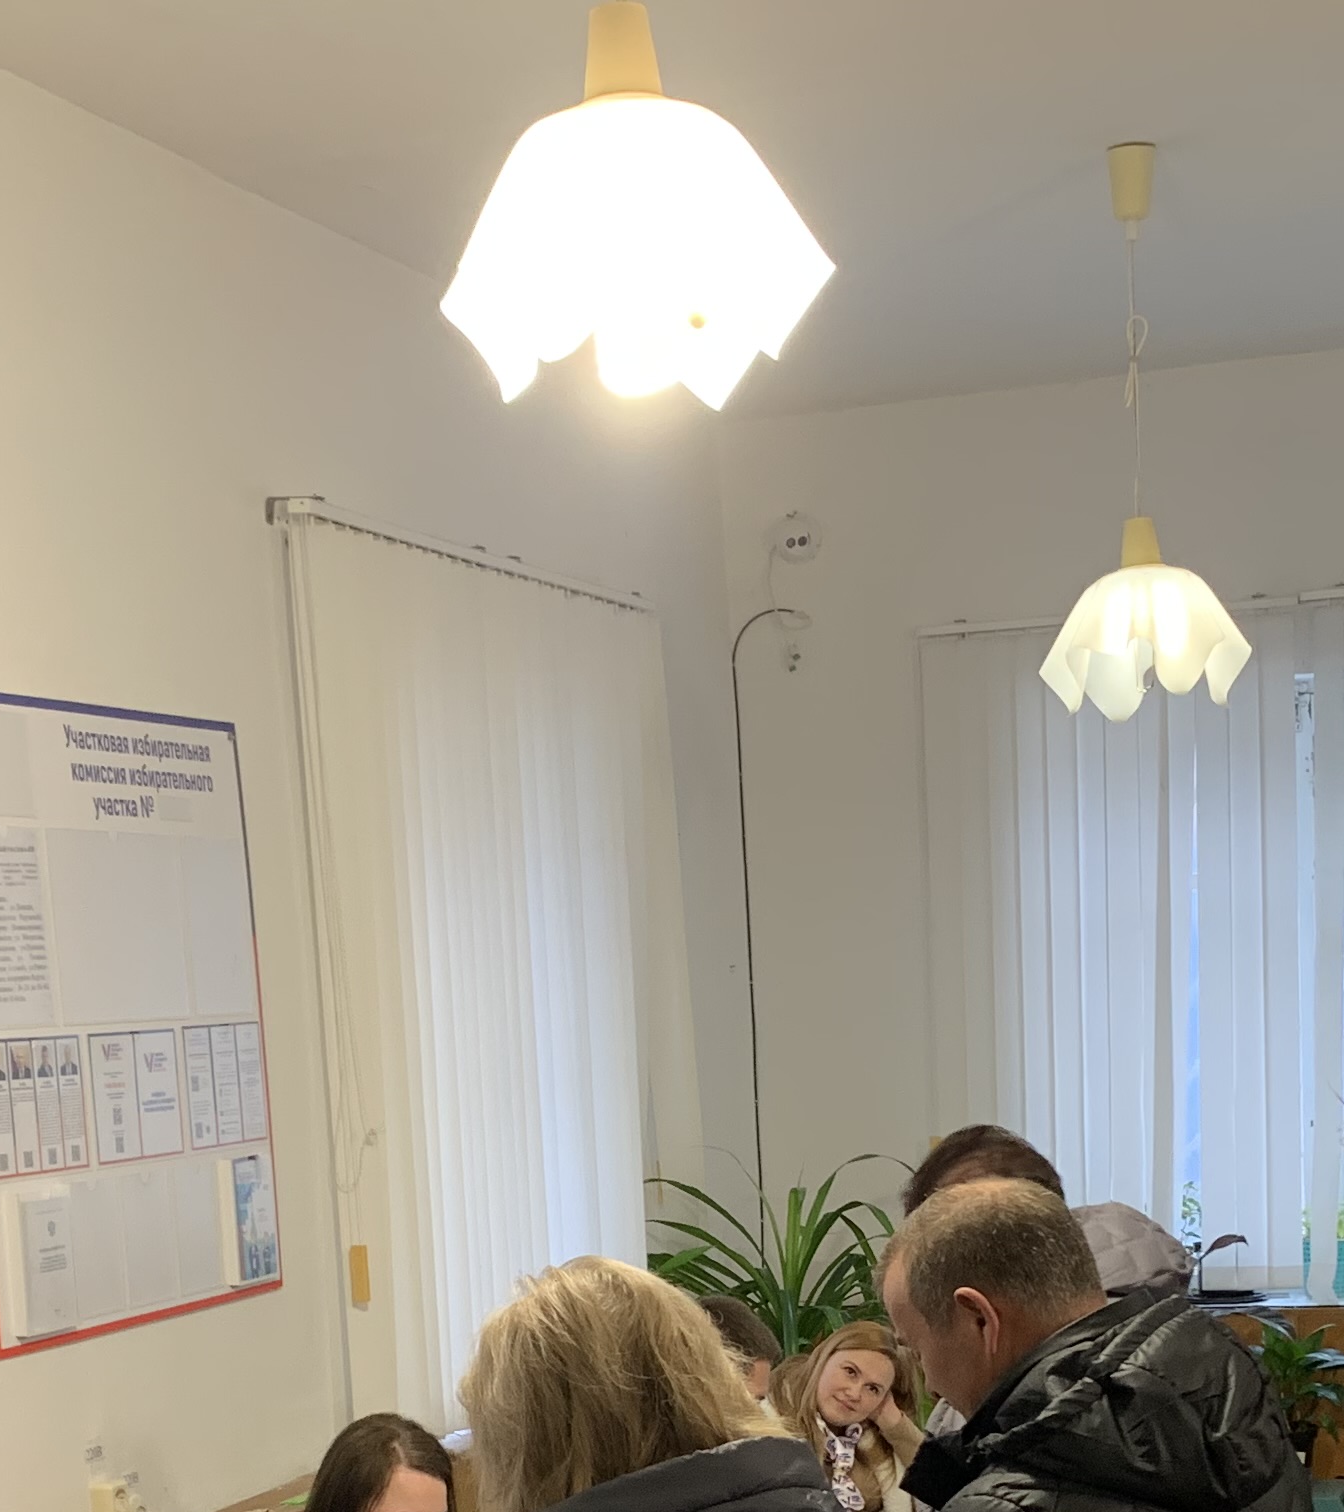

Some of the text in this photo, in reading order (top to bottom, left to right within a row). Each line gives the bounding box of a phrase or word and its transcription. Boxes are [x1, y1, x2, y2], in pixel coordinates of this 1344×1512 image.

[63, 724, 211, 763] Участковая избирательная
[71, 763, 213, 793] комиссия избирательного
[93, 795, 155, 820] участка №
